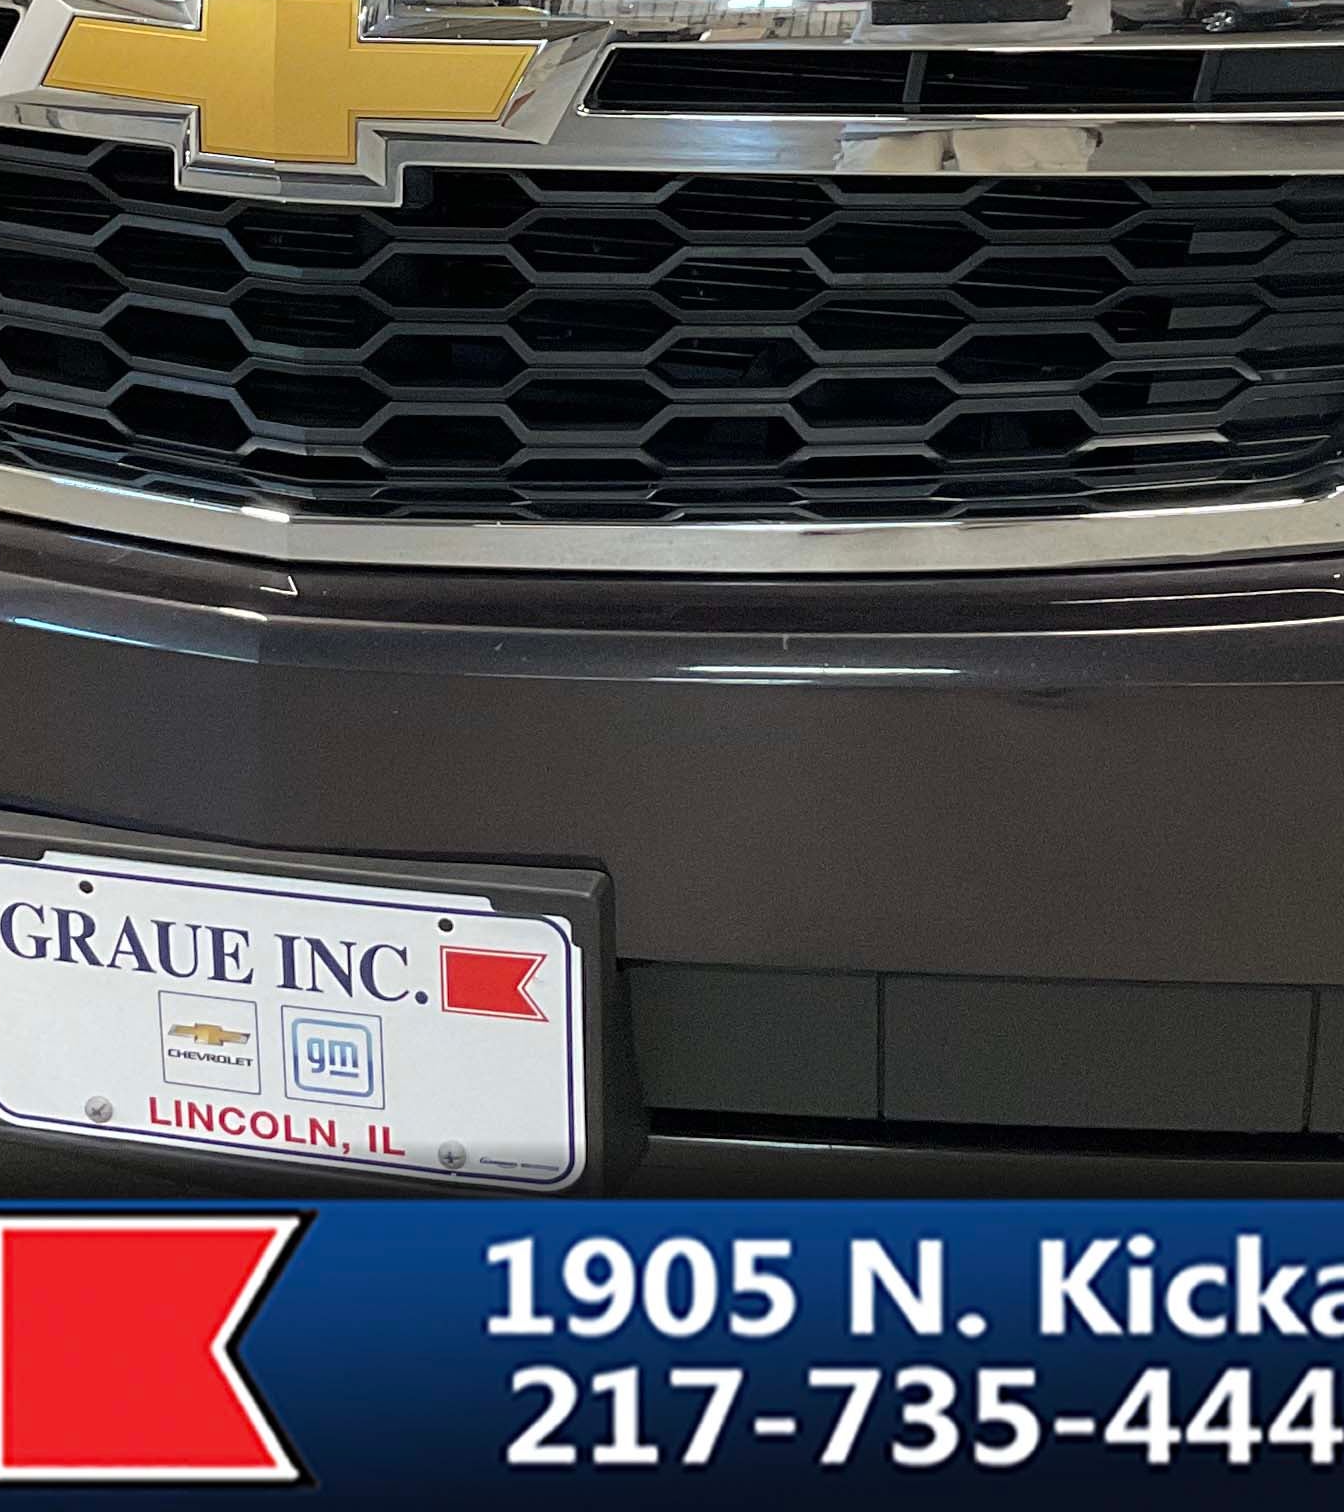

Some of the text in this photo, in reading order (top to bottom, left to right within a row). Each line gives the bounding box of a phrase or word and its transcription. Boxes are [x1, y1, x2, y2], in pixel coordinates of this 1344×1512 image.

[0, 901, 429, 1005] GRAUE INC.
[167, 1048, 253, 1068] CHEVROLET
[306, 1037, 359, 1078] gm
[149, 1096, 406, 1157] LINCOLN, IL
